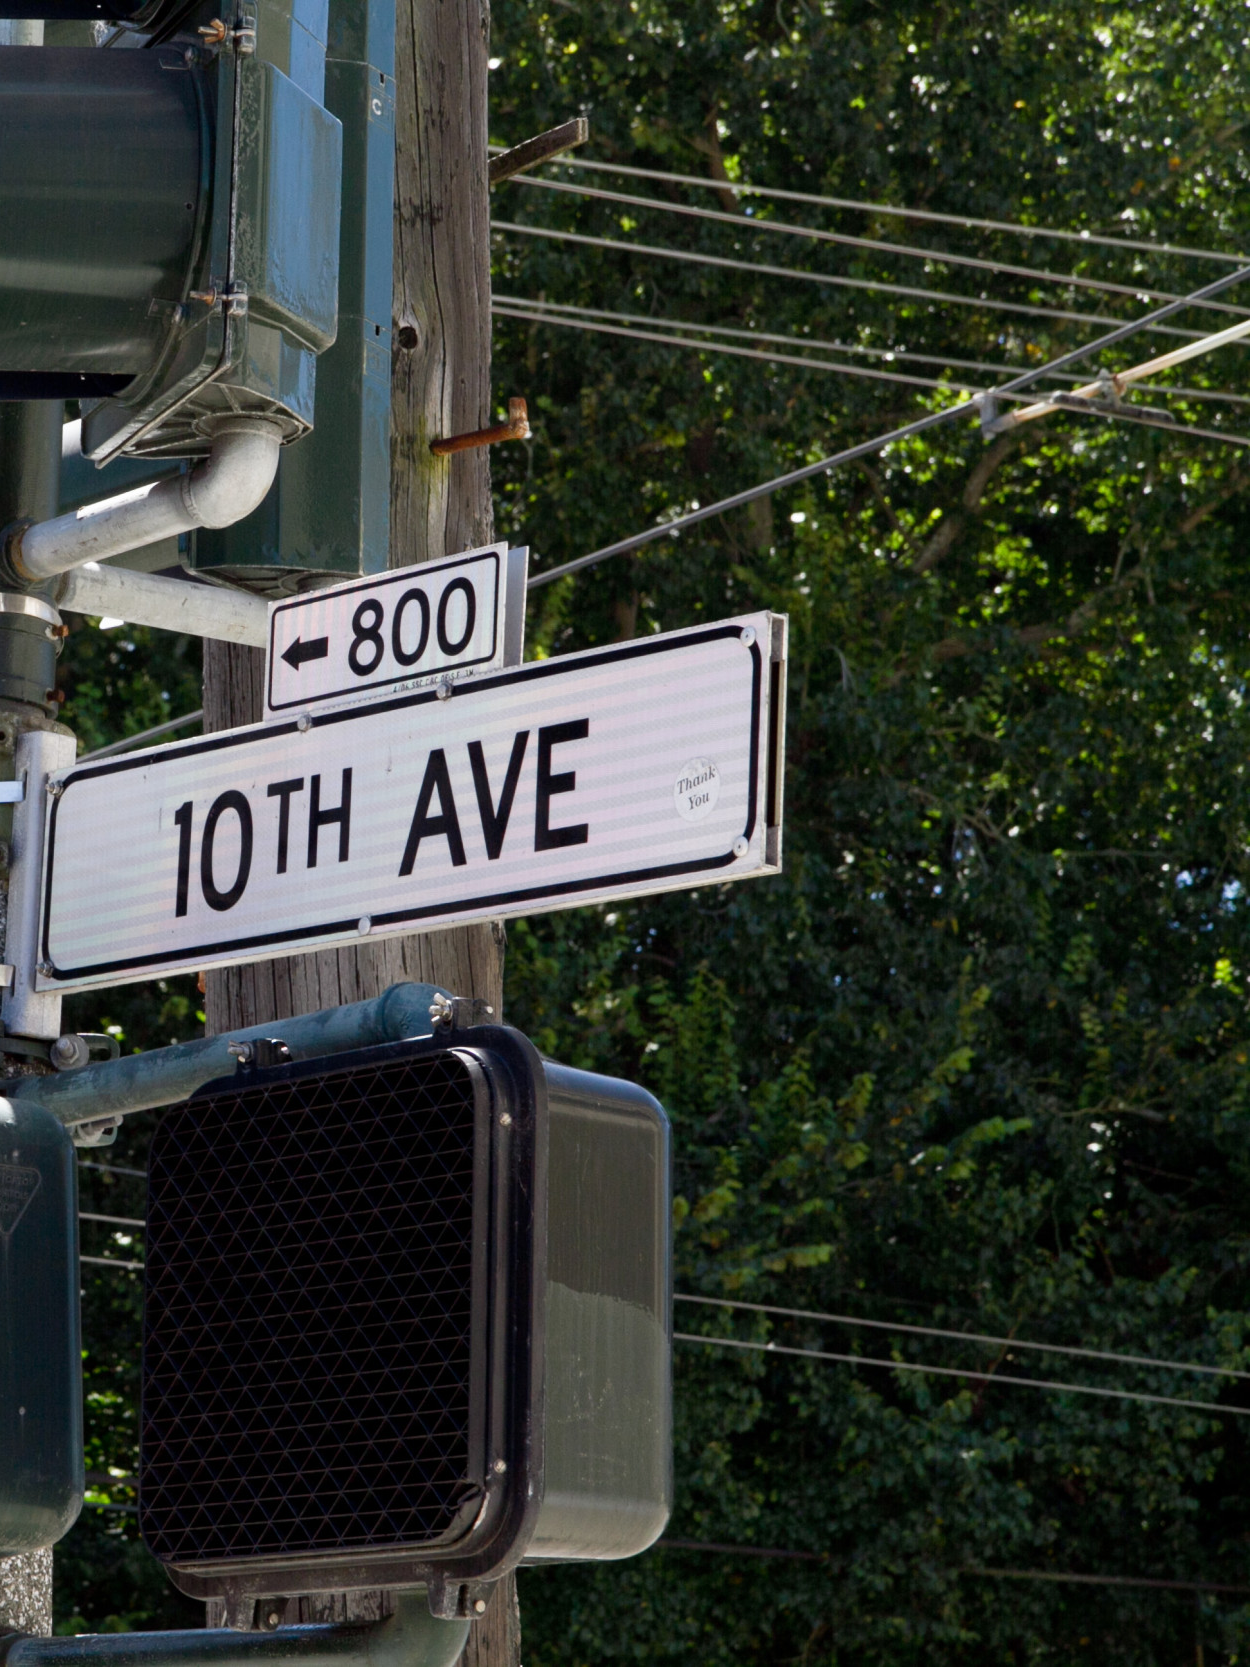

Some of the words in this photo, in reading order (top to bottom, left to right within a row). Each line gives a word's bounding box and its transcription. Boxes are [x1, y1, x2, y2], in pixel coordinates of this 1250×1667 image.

[348, 576, 477, 677] 800
[676, 765, 716, 795] Thank
[688, 792, 709, 810] You
[174, 767, 353, 918] 10TH
[398, 717, 590, 877] AVE
